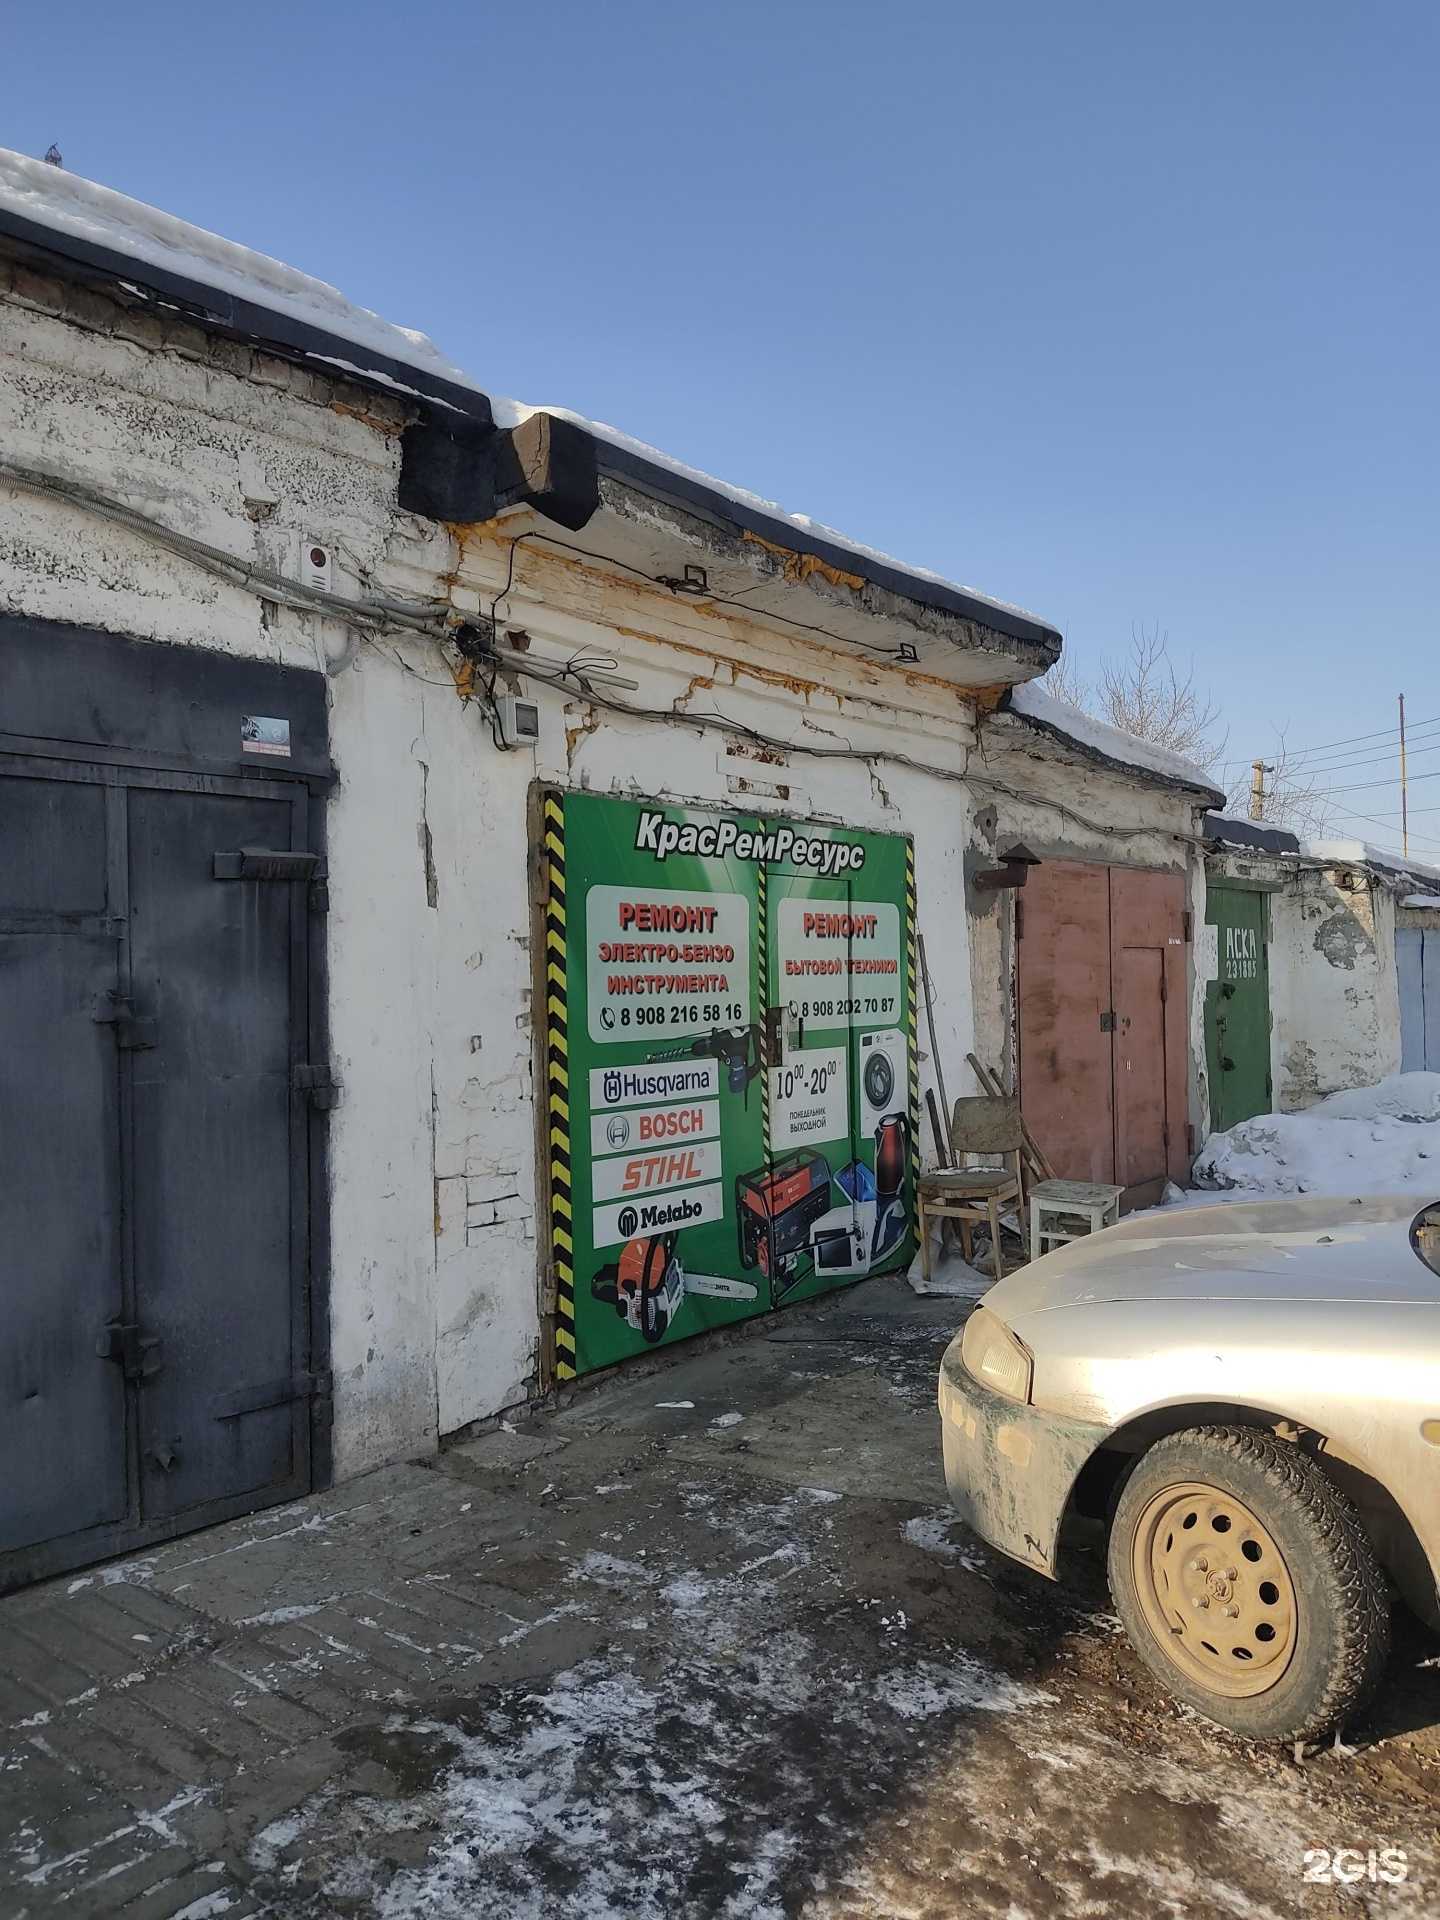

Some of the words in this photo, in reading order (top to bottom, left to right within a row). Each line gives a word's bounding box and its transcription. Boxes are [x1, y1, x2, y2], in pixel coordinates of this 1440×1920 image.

[635, 811, 865, 875] КрасРемРесурс
[619, 902, 718, 933] РЕМОНТ
[803, 912, 877, 939] РЕМОНТ
[598, 942, 735, 962] ЭЛЕКТРО-БЕНЗО
[785, 957, 842, 976] БЫТОВОЙ
[845, 959, 898, 975] ТЕХНИКИ
[607, 974, 729, 996] ИНСТРУМЕНТА
[620, 1007, 631, 1026] 8
[636, 1007, 665, 1025] 908
[670, 1005, 698, 1023] 216
[703, 1004, 720, 1021] 58
[725, 1003, 742, 1020] 16
[802, 1001, 809, 1017] 8
[813, 1000, 833, 1016] 908
[837, 999, 861, 1015] 202
[865, 998, 878, 1013] 70
[881, 997, 894, 1012] 87
[623, 1071, 710, 1097] Husqvarna
[639, 1108, 703, 1140] BOSCH
[789, 1107, 827, 1120] ПОНЕДЕЛЬНИК
[790, 1116, 827, 1133] ВЫХОДНОЙ
[622, 1151, 702, 1191] STIHL
[640, 1199, 703, 1229] Metabo
